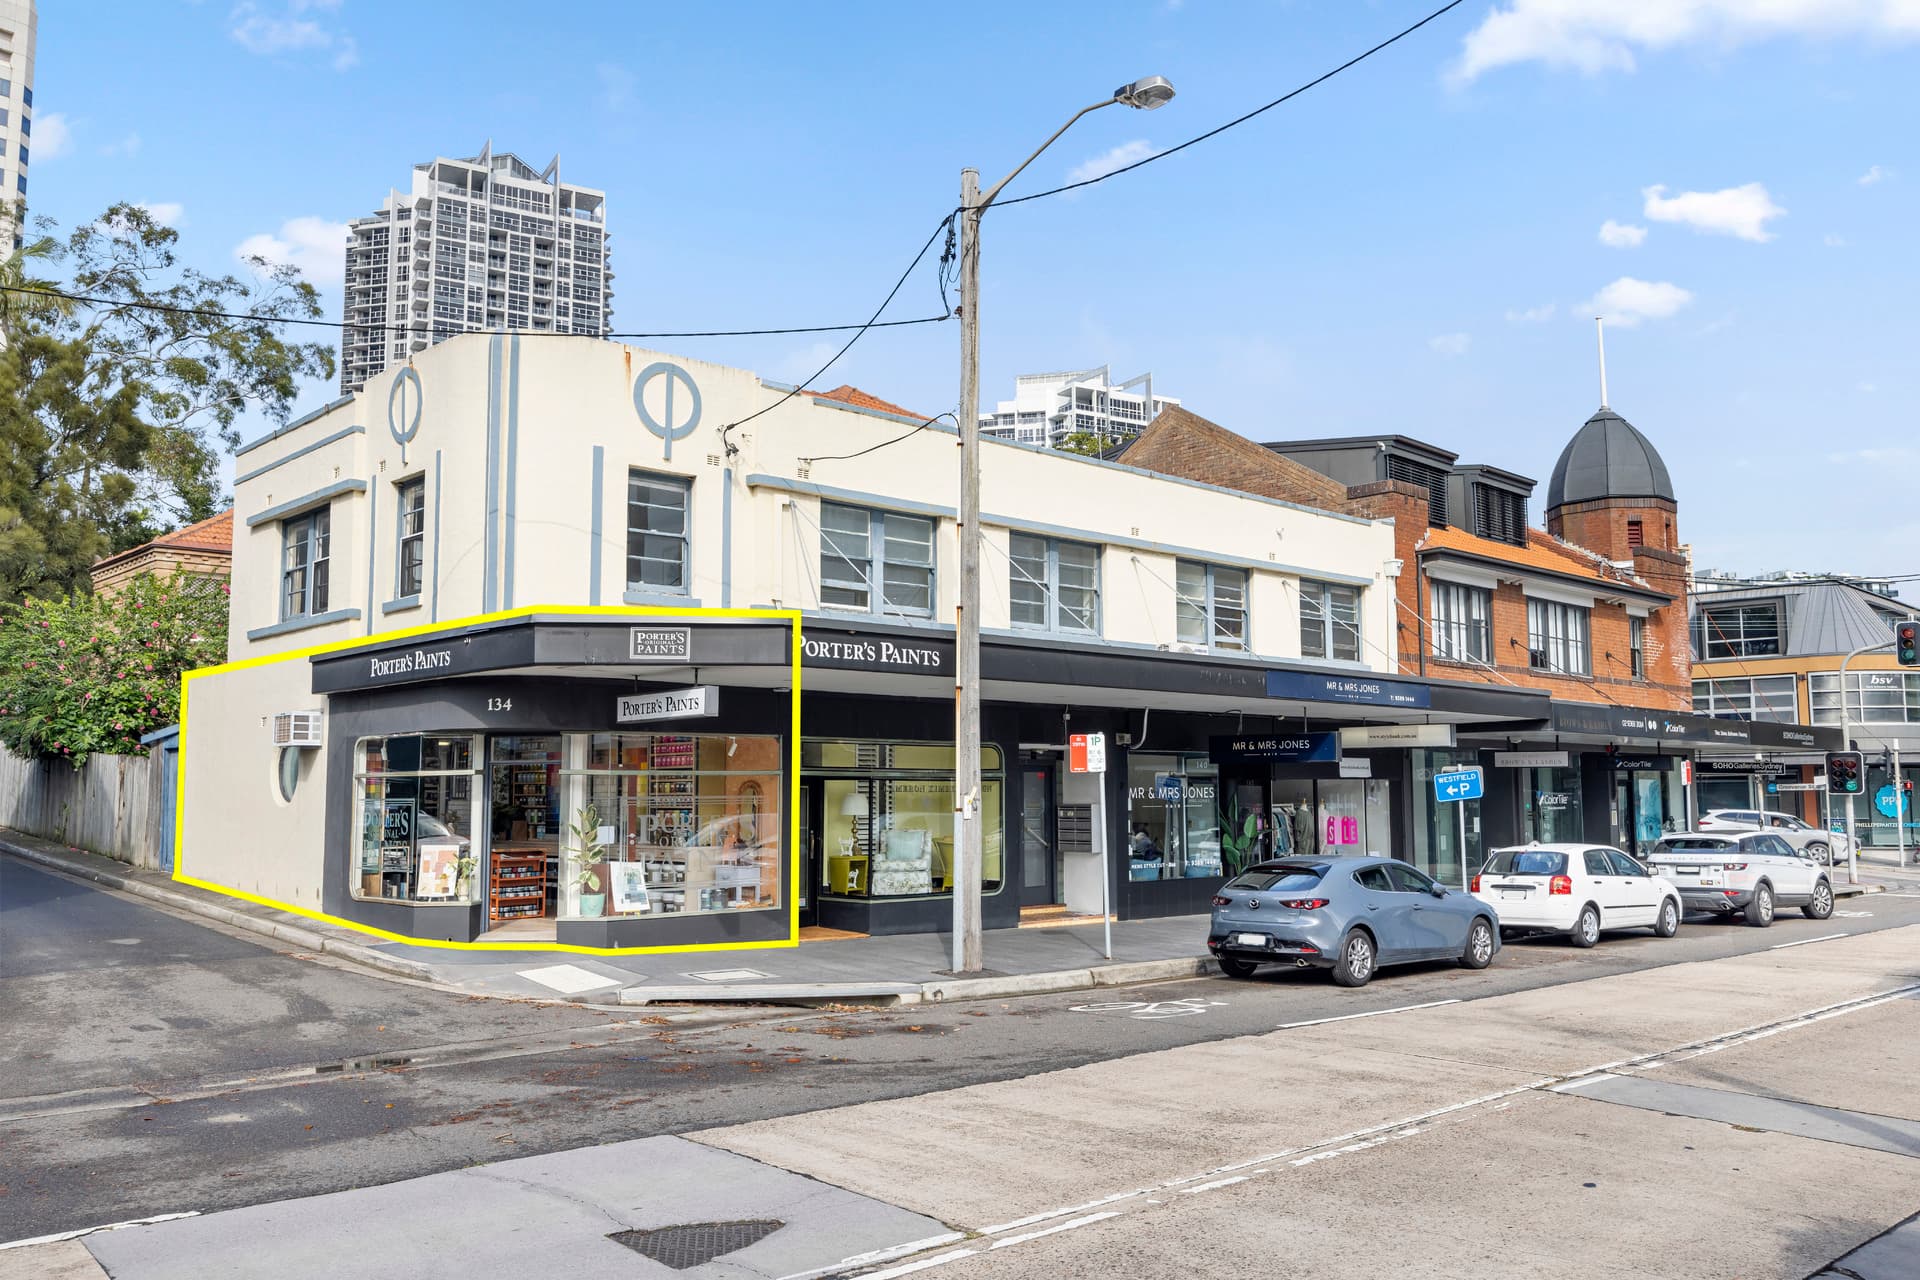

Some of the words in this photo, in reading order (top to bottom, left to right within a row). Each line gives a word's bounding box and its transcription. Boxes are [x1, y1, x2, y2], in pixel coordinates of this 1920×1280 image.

[637, 632, 685, 643] PORTER'S
[637, 645, 684, 654] PAINTS
[880, 642, 940, 666] PAINTS
[370, 654, 413, 678] PORTER'S
[415, 650, 451, 671] PAINTS
[1871, 675, 1893, 684] bsv
[1326, 681, 1337, 690] MR
[1338, 682, 1343, 691] &
[1344, 683, 1358, 692] MRS
[1359, 684, 1380, 694] JONES
[487, 698, 512, 711] 134
[622, 699, 662, 717] PORTER'S
[665, 696, 699, 713] PAINTS
[1091, 736, 1101, 746] 1P
[1232, 741, 1246, 750] MR
[1248, 741, 1255, 750] &
[1257, 741, 1277, 749] MRS
[1279, 740, 1310, 749] JONES
[1623, 760, 1652, 768] ColorTile
[1438, 773, 1477, 785] WESTFIELD
[1129, 787, 1145, 799] MR
[1148, 787, 1155, 799] &
[1158, 787, 1180, 799] MRS
[1182, 787, 1215, 799] JONES
[1460, 782, 1470, 795] P
